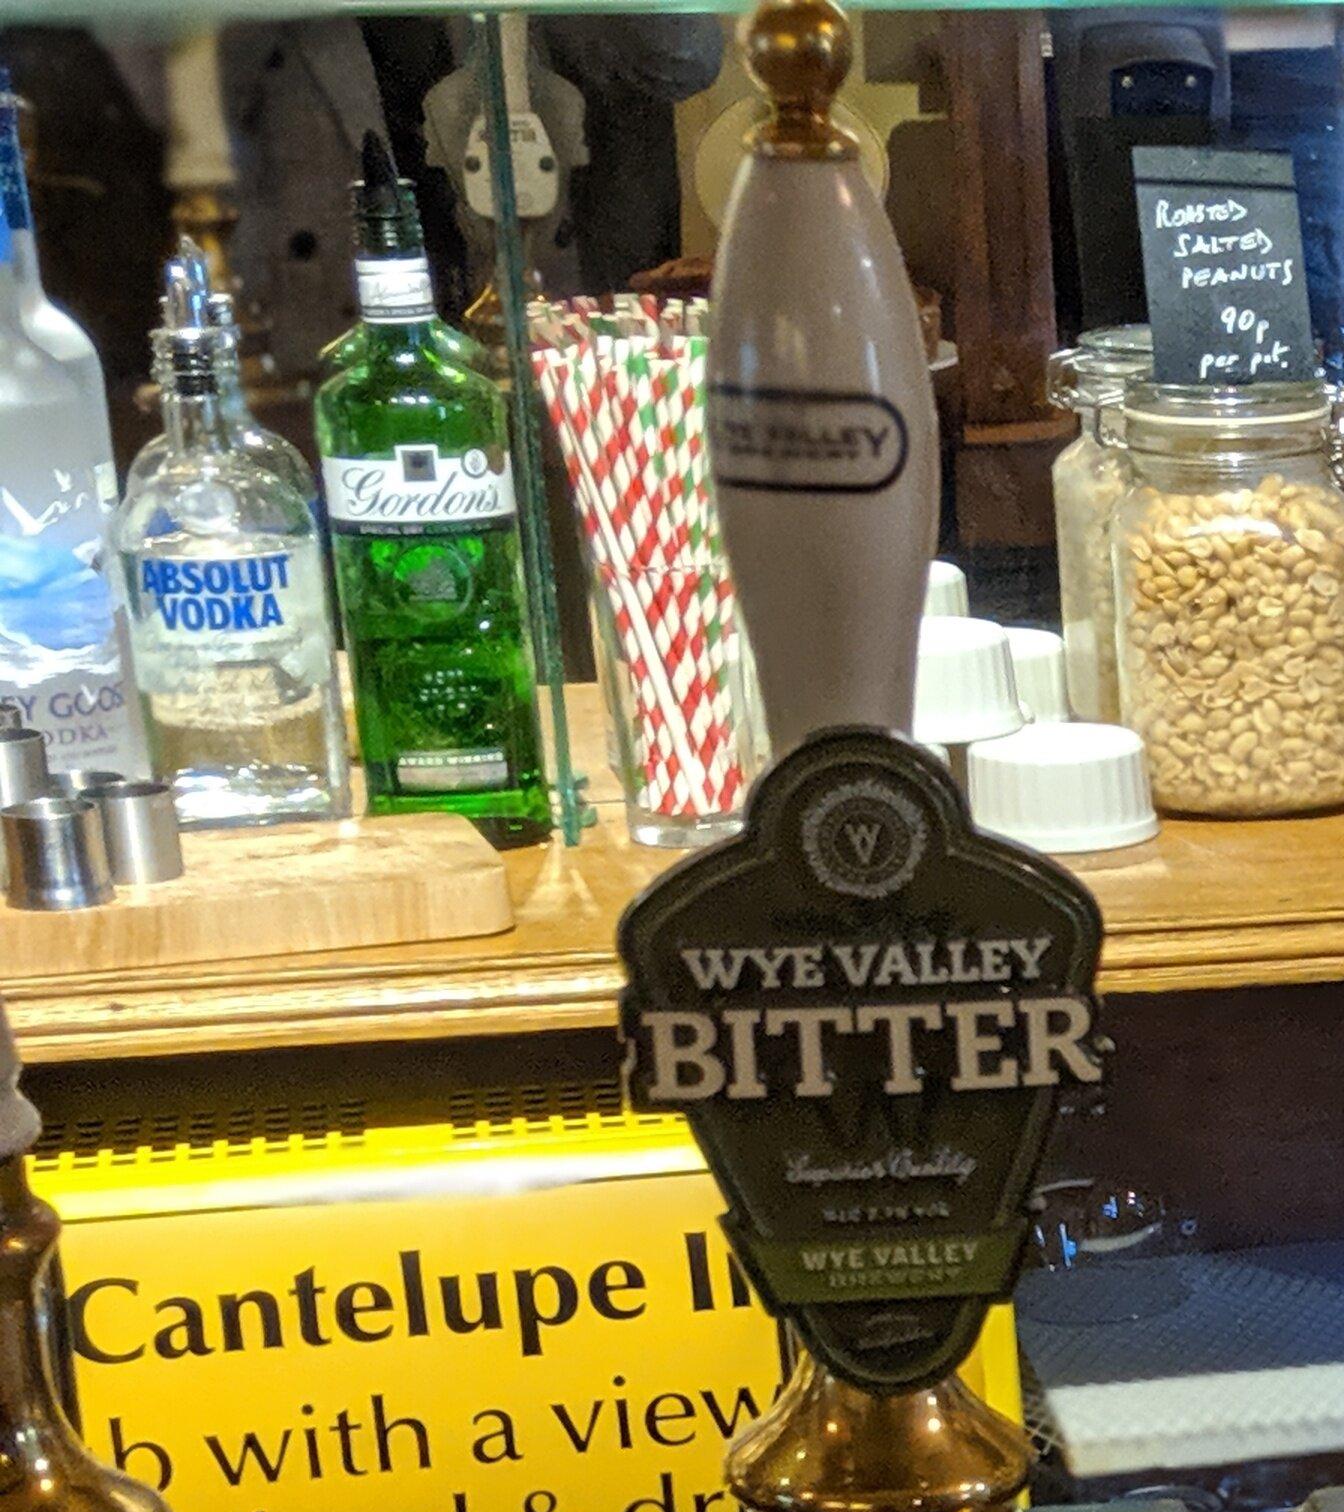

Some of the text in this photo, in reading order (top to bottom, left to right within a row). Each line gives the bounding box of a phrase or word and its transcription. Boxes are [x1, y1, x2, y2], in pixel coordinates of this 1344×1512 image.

[1173, 228, 1274, 258] SALTED
[1181, 258, 1294, 289] PEANUTS
[1220, 305, 1270, 345] 90p
[1200, 353, 1240, 379] per
[341, 466, 500, 518] Gordon's
[142, 553, 289, 595] ABSOLUT
[155, 593, 284, 632] VODKA
[681, 936, 1054, 991] WYE VALLEY
[640, 997, 1103, 1102] BITTER
[802, 1241, 979, 1272] WYE VALLEY
[67, 1230, 753, 1365] Cantelupe I
[203, 1393, 433, 1487] with
[471, 1408, 525, 1465] a
[549, 1373, 784, 1454] view
